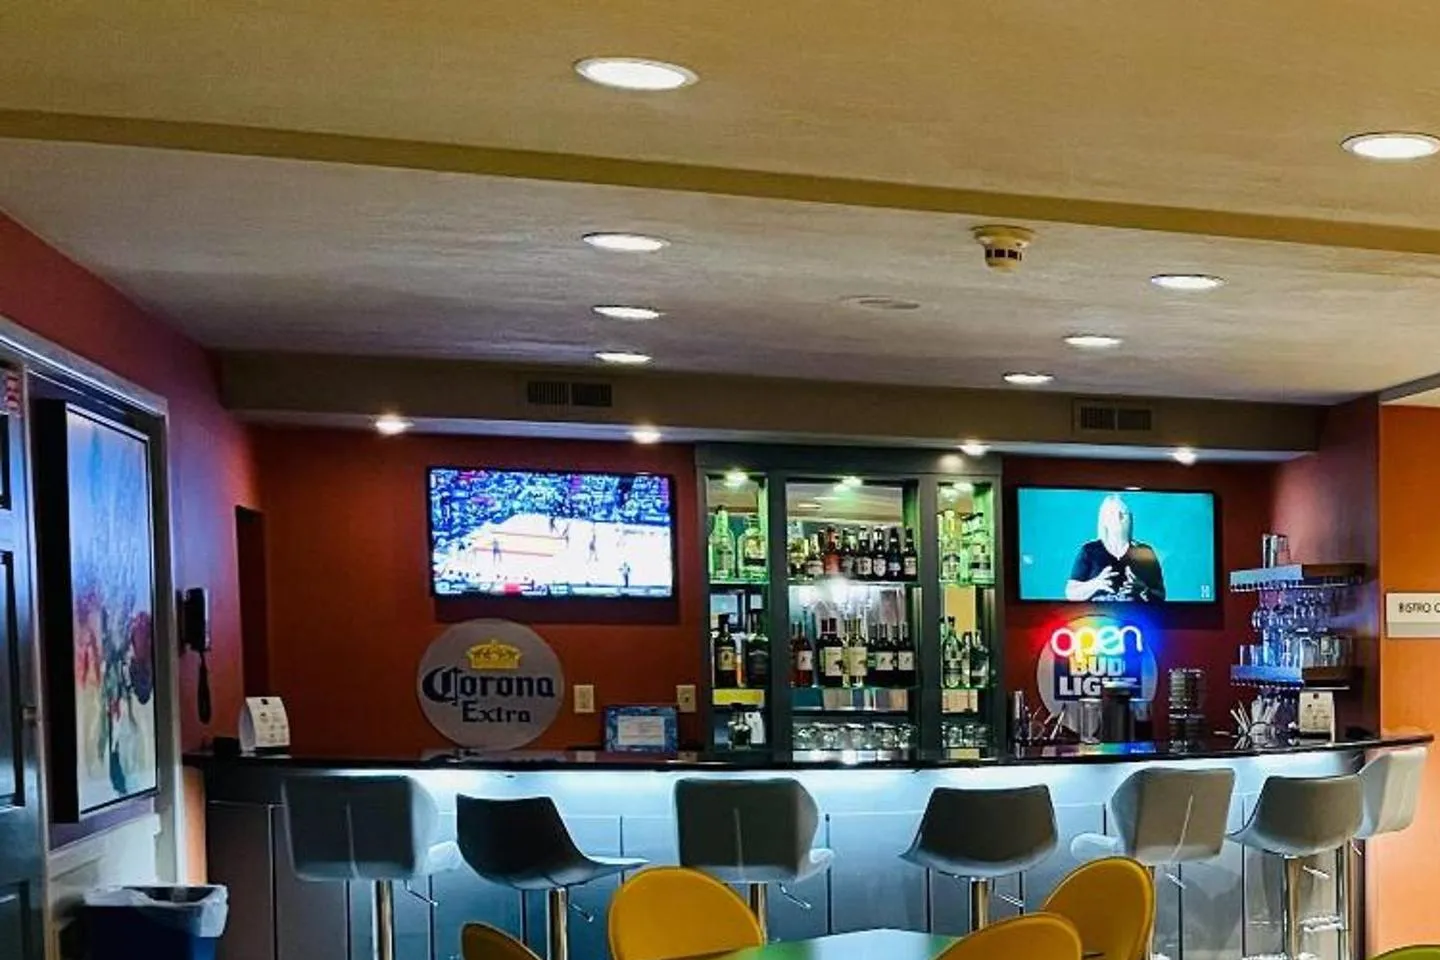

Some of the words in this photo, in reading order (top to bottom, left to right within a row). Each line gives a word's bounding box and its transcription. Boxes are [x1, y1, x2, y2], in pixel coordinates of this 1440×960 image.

[1398, 602, 1431, 613] BISTRO
[1433, 602, 1440, 613] C
[1050, 625, 1143, 661] open
[1069, 655, 1122, 676] BUD
[422, 666, 555, 706] Corona
[1059, 676, 1137, 696] LIG
[462, 701, 531, 723] Extra
